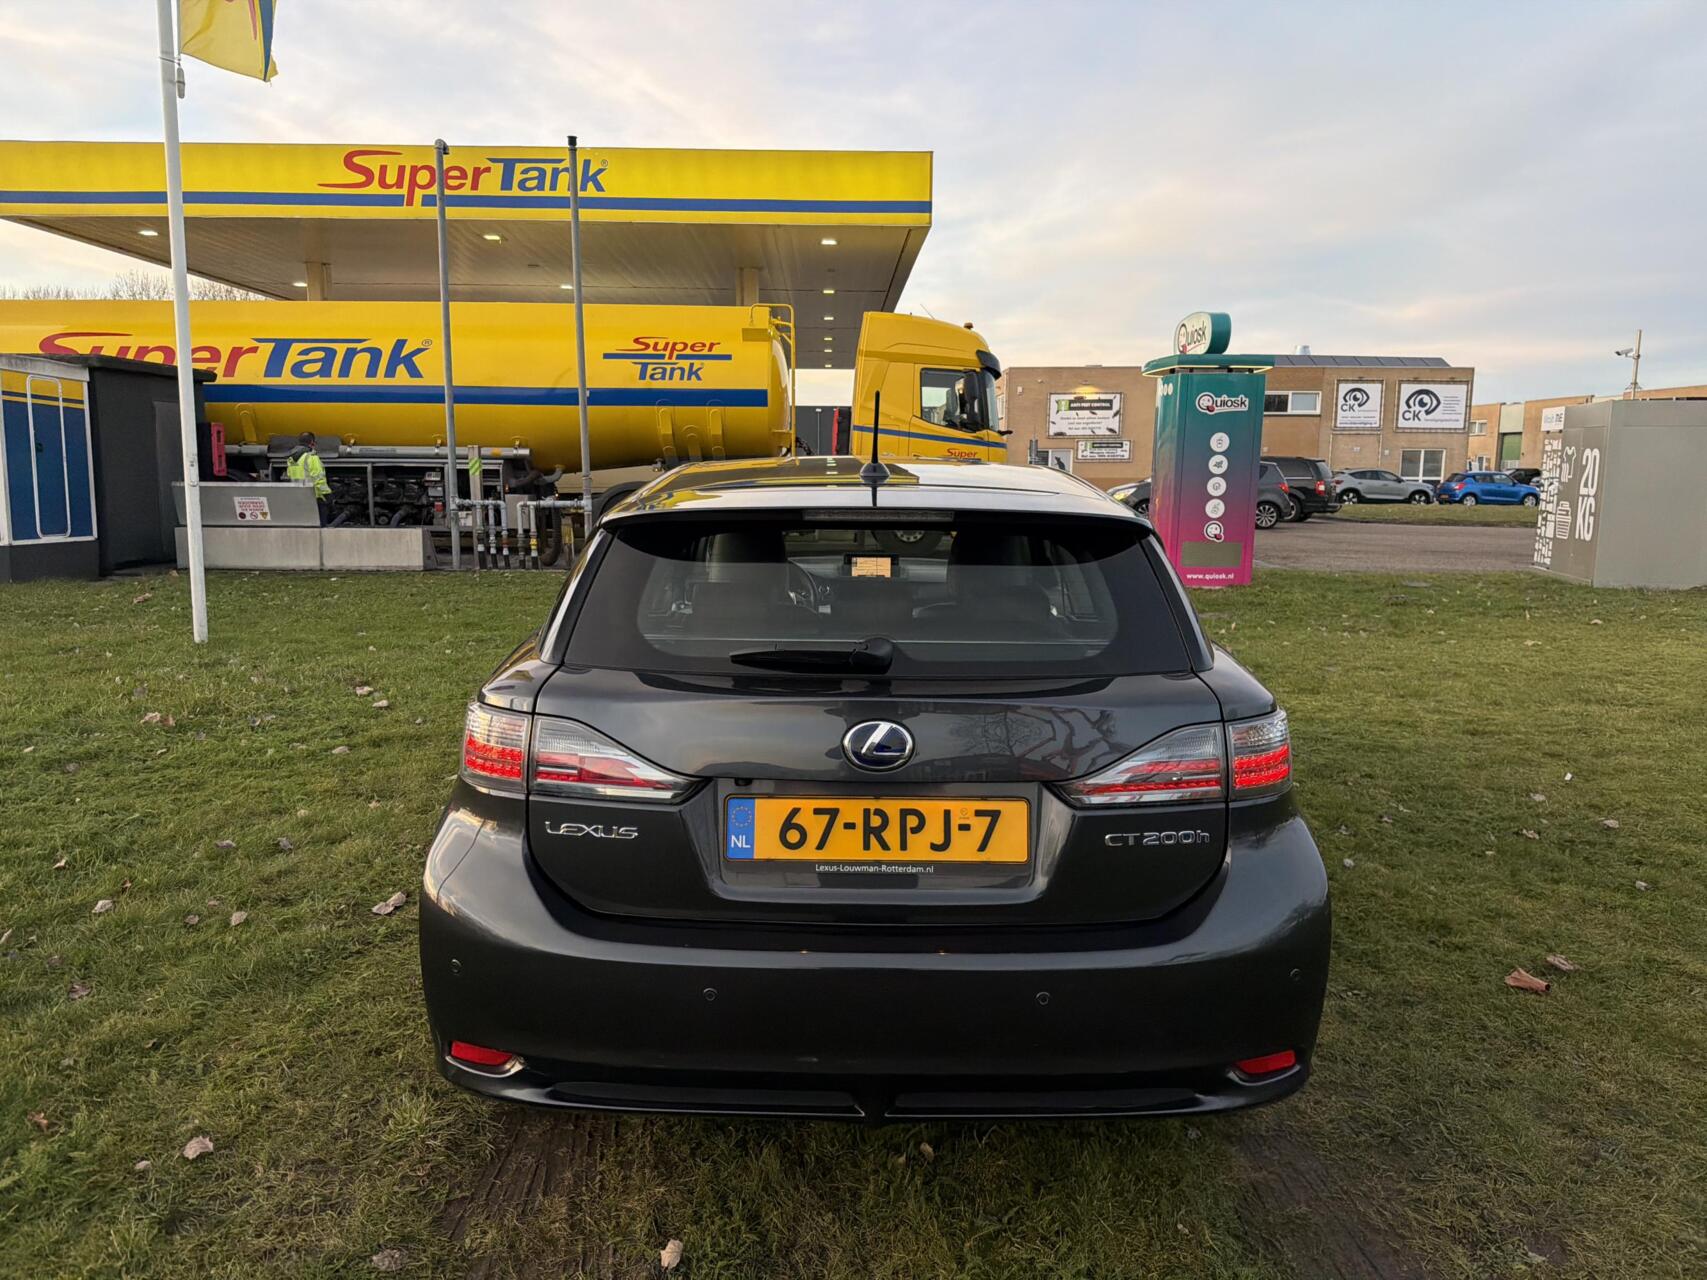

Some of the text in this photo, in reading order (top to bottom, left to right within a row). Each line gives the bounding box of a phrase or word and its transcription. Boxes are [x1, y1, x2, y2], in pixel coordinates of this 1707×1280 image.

[1178, 320, 1207, 354] Quiosk
[615, 336, 721, 360] Super
[631, 361, 704, 381] Tank
[1197, 393, 1248, 412] Quiosk
[1340, 403, 1356, 412] CK
[1402, 410, 1421, 421] CK
[945, 448, 978, 459] Super
[1580, 448, 1600, 496] 20
[1575, 496, 1596, 541] KG
[544, 821, 639, 839] LEXUS
[778, 807, 1002, 852] 67-RPJ-7
[731, 834, 751, 849] NL
[815, 864, 935, 874] Lexus-Louwman-Rotterdam.nl
